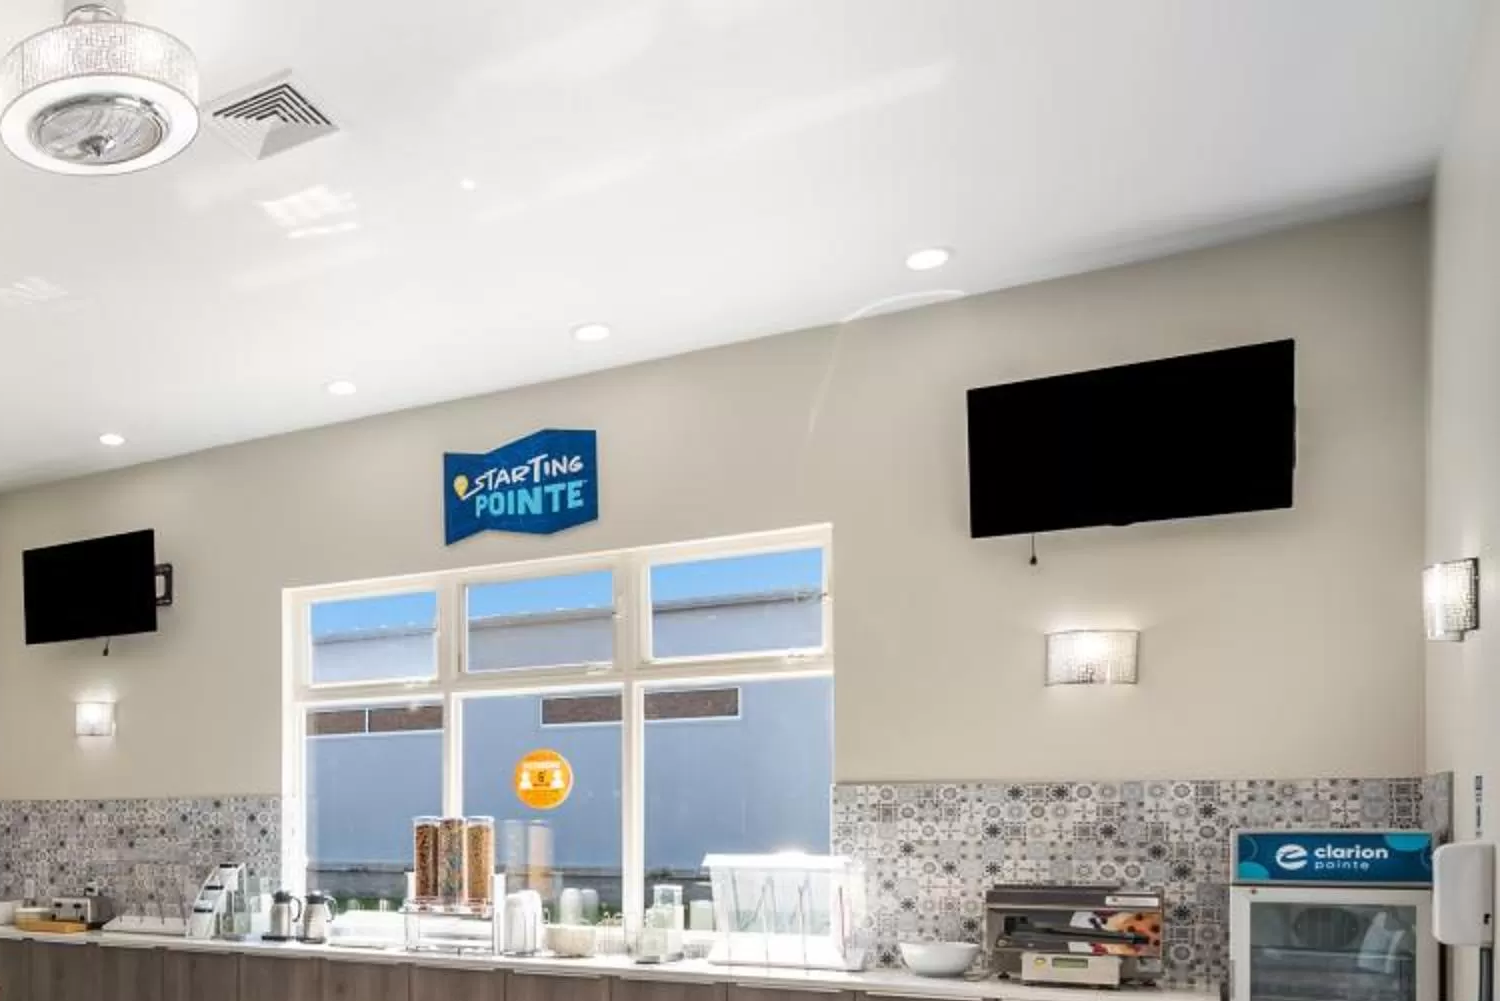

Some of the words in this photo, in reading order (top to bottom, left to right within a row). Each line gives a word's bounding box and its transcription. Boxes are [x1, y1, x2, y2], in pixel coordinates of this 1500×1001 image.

[468, 453, 584, 496] STARTING
[475, 480, 584, 518] POINTE
[1314, 844, 1388, 860] clarion
[1314, 861, 1370, 870] pointe
